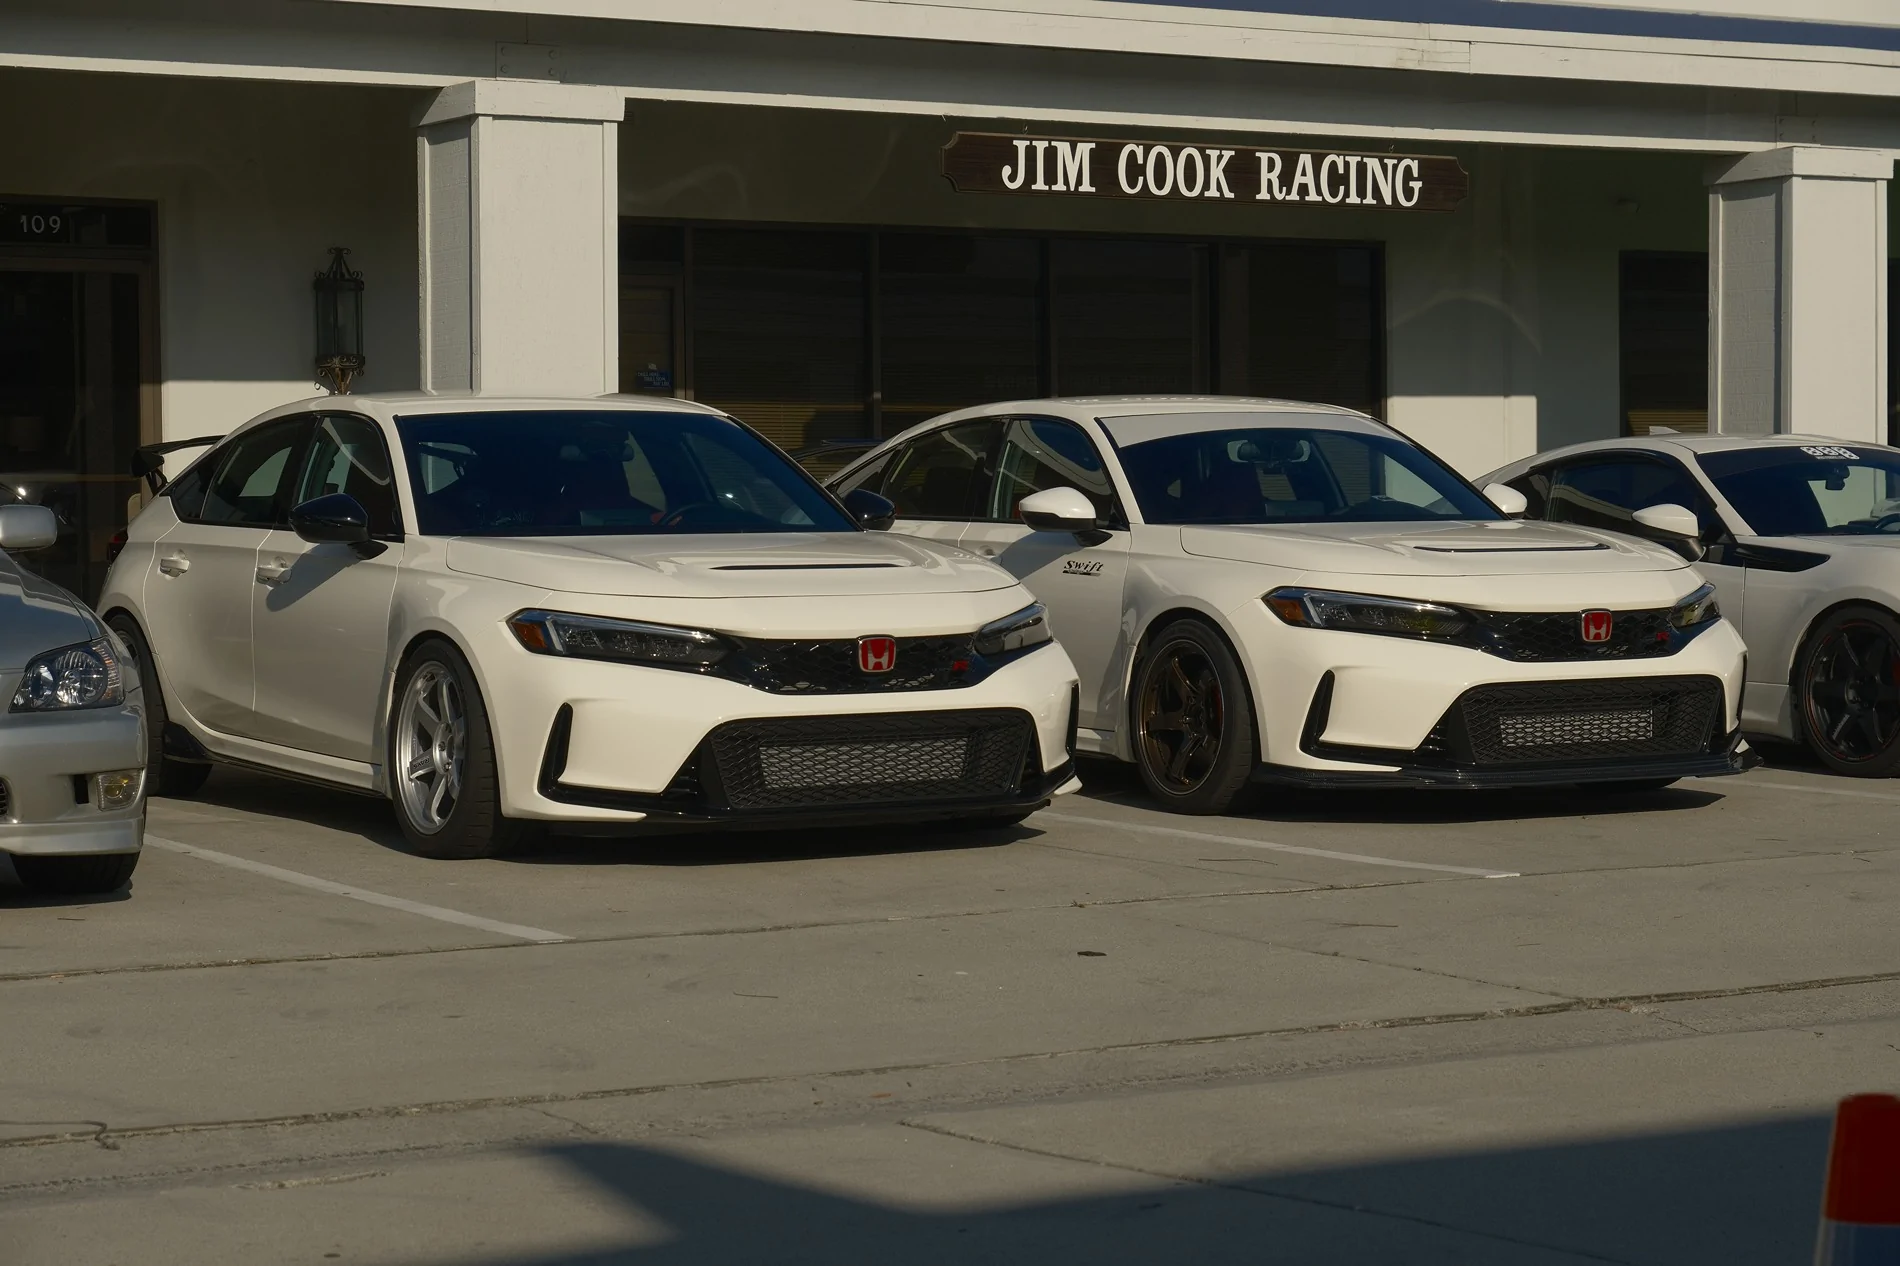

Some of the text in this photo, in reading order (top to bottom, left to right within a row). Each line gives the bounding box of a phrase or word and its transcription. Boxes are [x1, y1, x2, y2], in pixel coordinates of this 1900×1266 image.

[1001, 139, 1423, 207] JIM COOK RACING
[20, 214, 61, 234] 109
[1063, 559, 1104, 573] Swift
